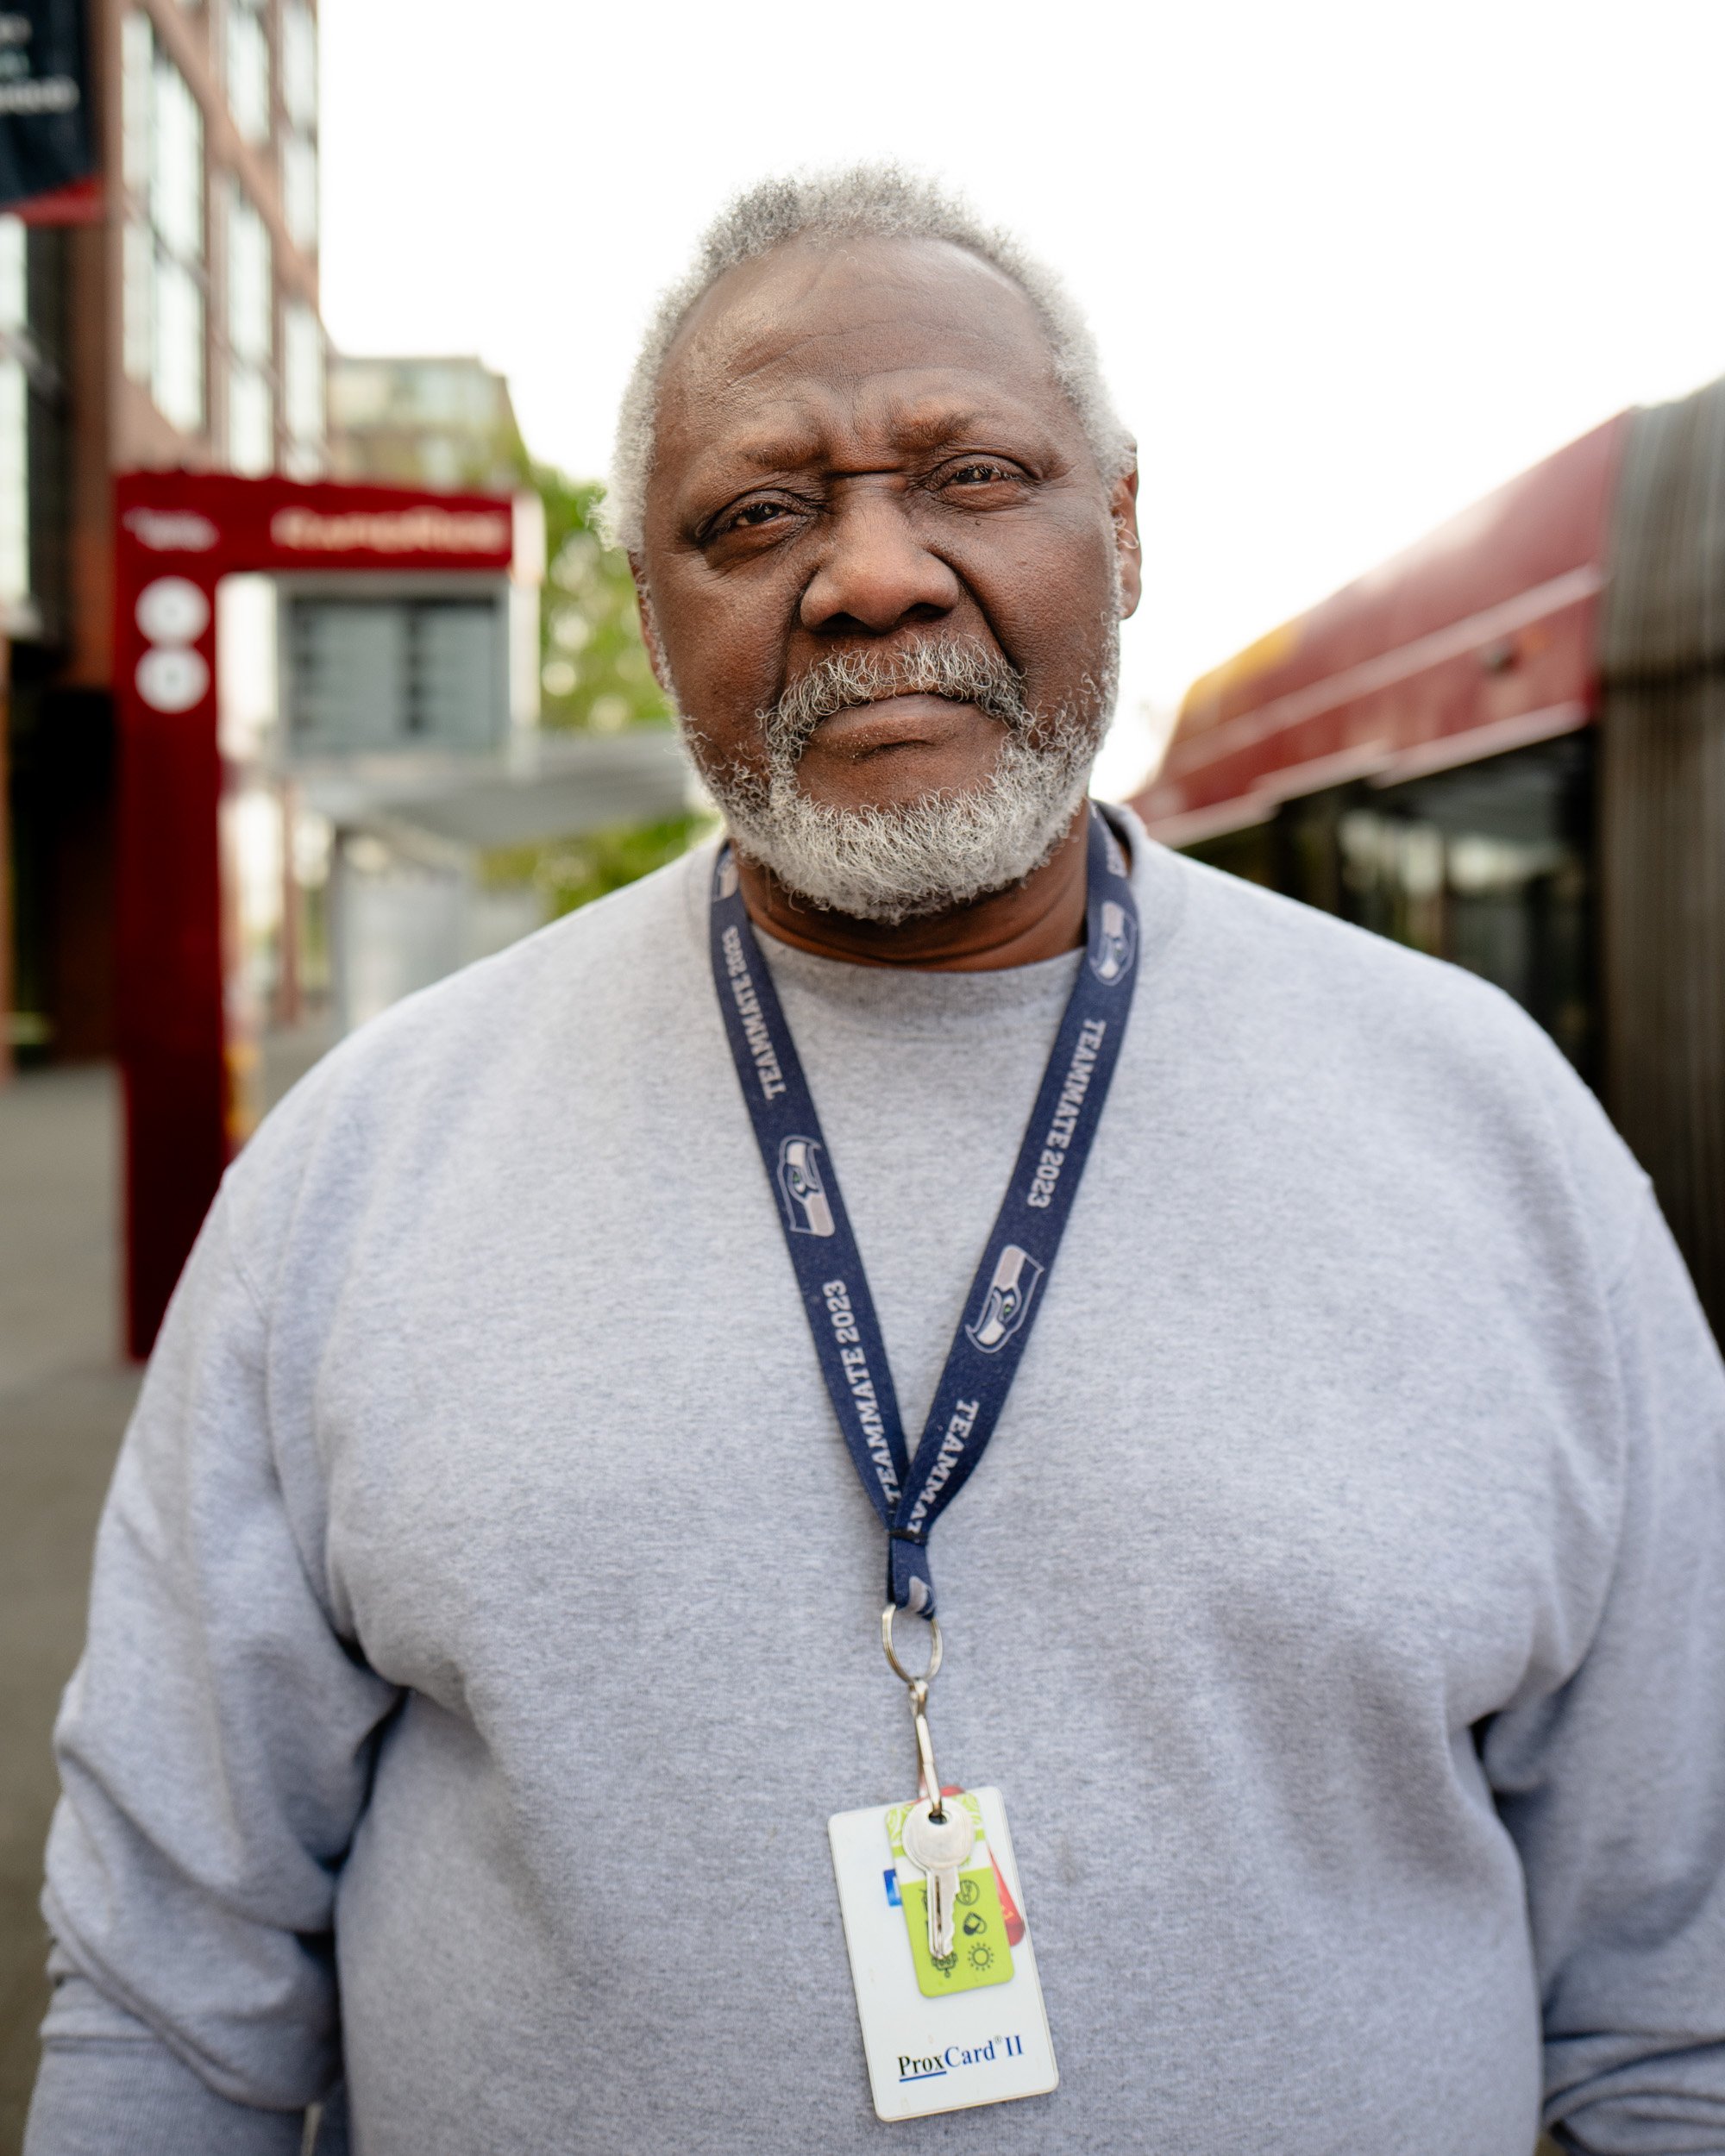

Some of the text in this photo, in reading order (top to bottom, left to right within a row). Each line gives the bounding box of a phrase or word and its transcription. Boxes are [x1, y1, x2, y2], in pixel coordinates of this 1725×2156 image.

[722, 924, 787, 1100] TEAMMATE 2023
[1027, 1018, 1107, 1209] TEAMMATE 2023
[822, 1279, 902, 1504] TEAMMATE 2023
[1005, 2034, 1025, 2058] II
